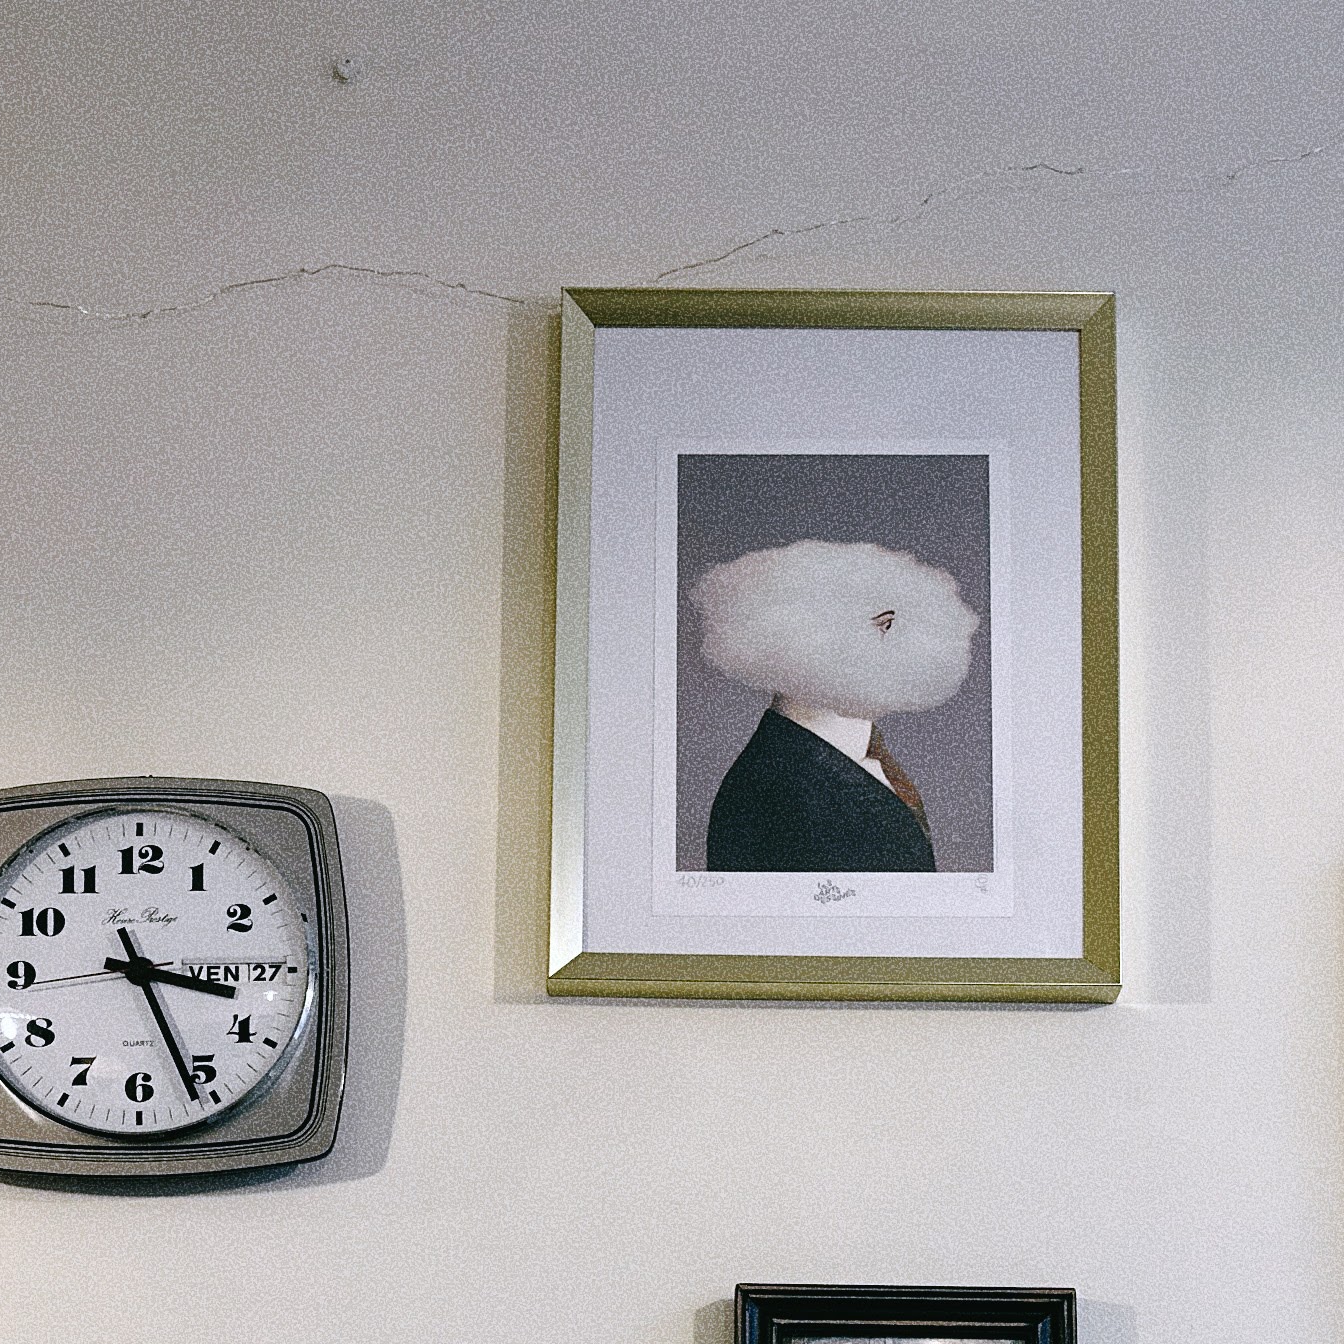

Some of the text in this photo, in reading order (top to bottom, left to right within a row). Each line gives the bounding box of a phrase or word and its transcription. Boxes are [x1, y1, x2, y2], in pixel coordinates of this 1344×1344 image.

[118, 844, 165, 876] 12
[58, 864, 100, 894] 11
[188, 862, 207, 893] 1
[18, 906, 66, 938] 10
[225, 903, 254, 933] 2
[6, 960, 37, 990] 9
[188, 964, 283, 982] VEN 27
[25, 1016, 56, 1047] 8
[122, 1040, 155, 1048] QUARTZ
[227, 1014, 257, 1044] 4
[69, 1056, 97, 1087] 7
[190, 1054, 217, 1085] 5
[124, 1071, 155, 1103] 6
